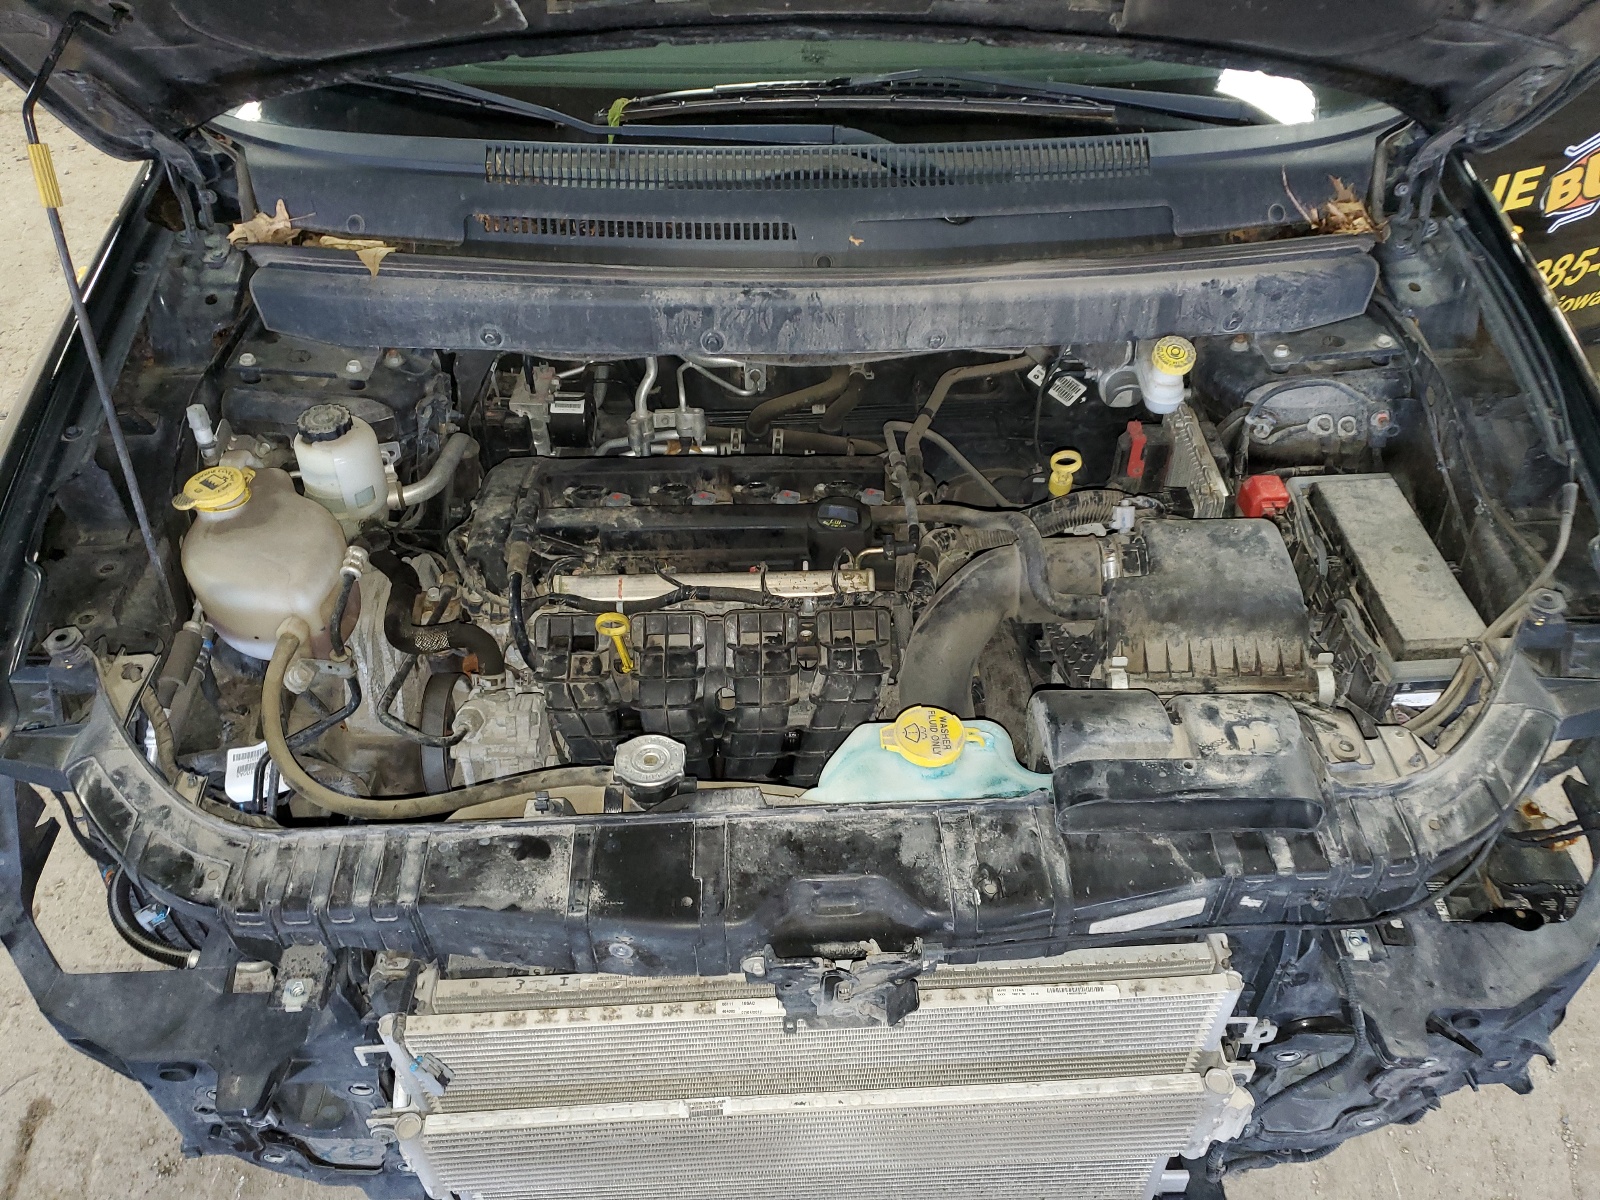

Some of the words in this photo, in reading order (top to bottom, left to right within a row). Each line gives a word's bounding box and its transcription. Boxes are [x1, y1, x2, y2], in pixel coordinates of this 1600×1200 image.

[1537, 247, 1600, 290] 85-
[928, 710, 939, 733] FLUID
[939, 716, 951, 750] WASHER
[931, 735, 941, 755] ONLY
